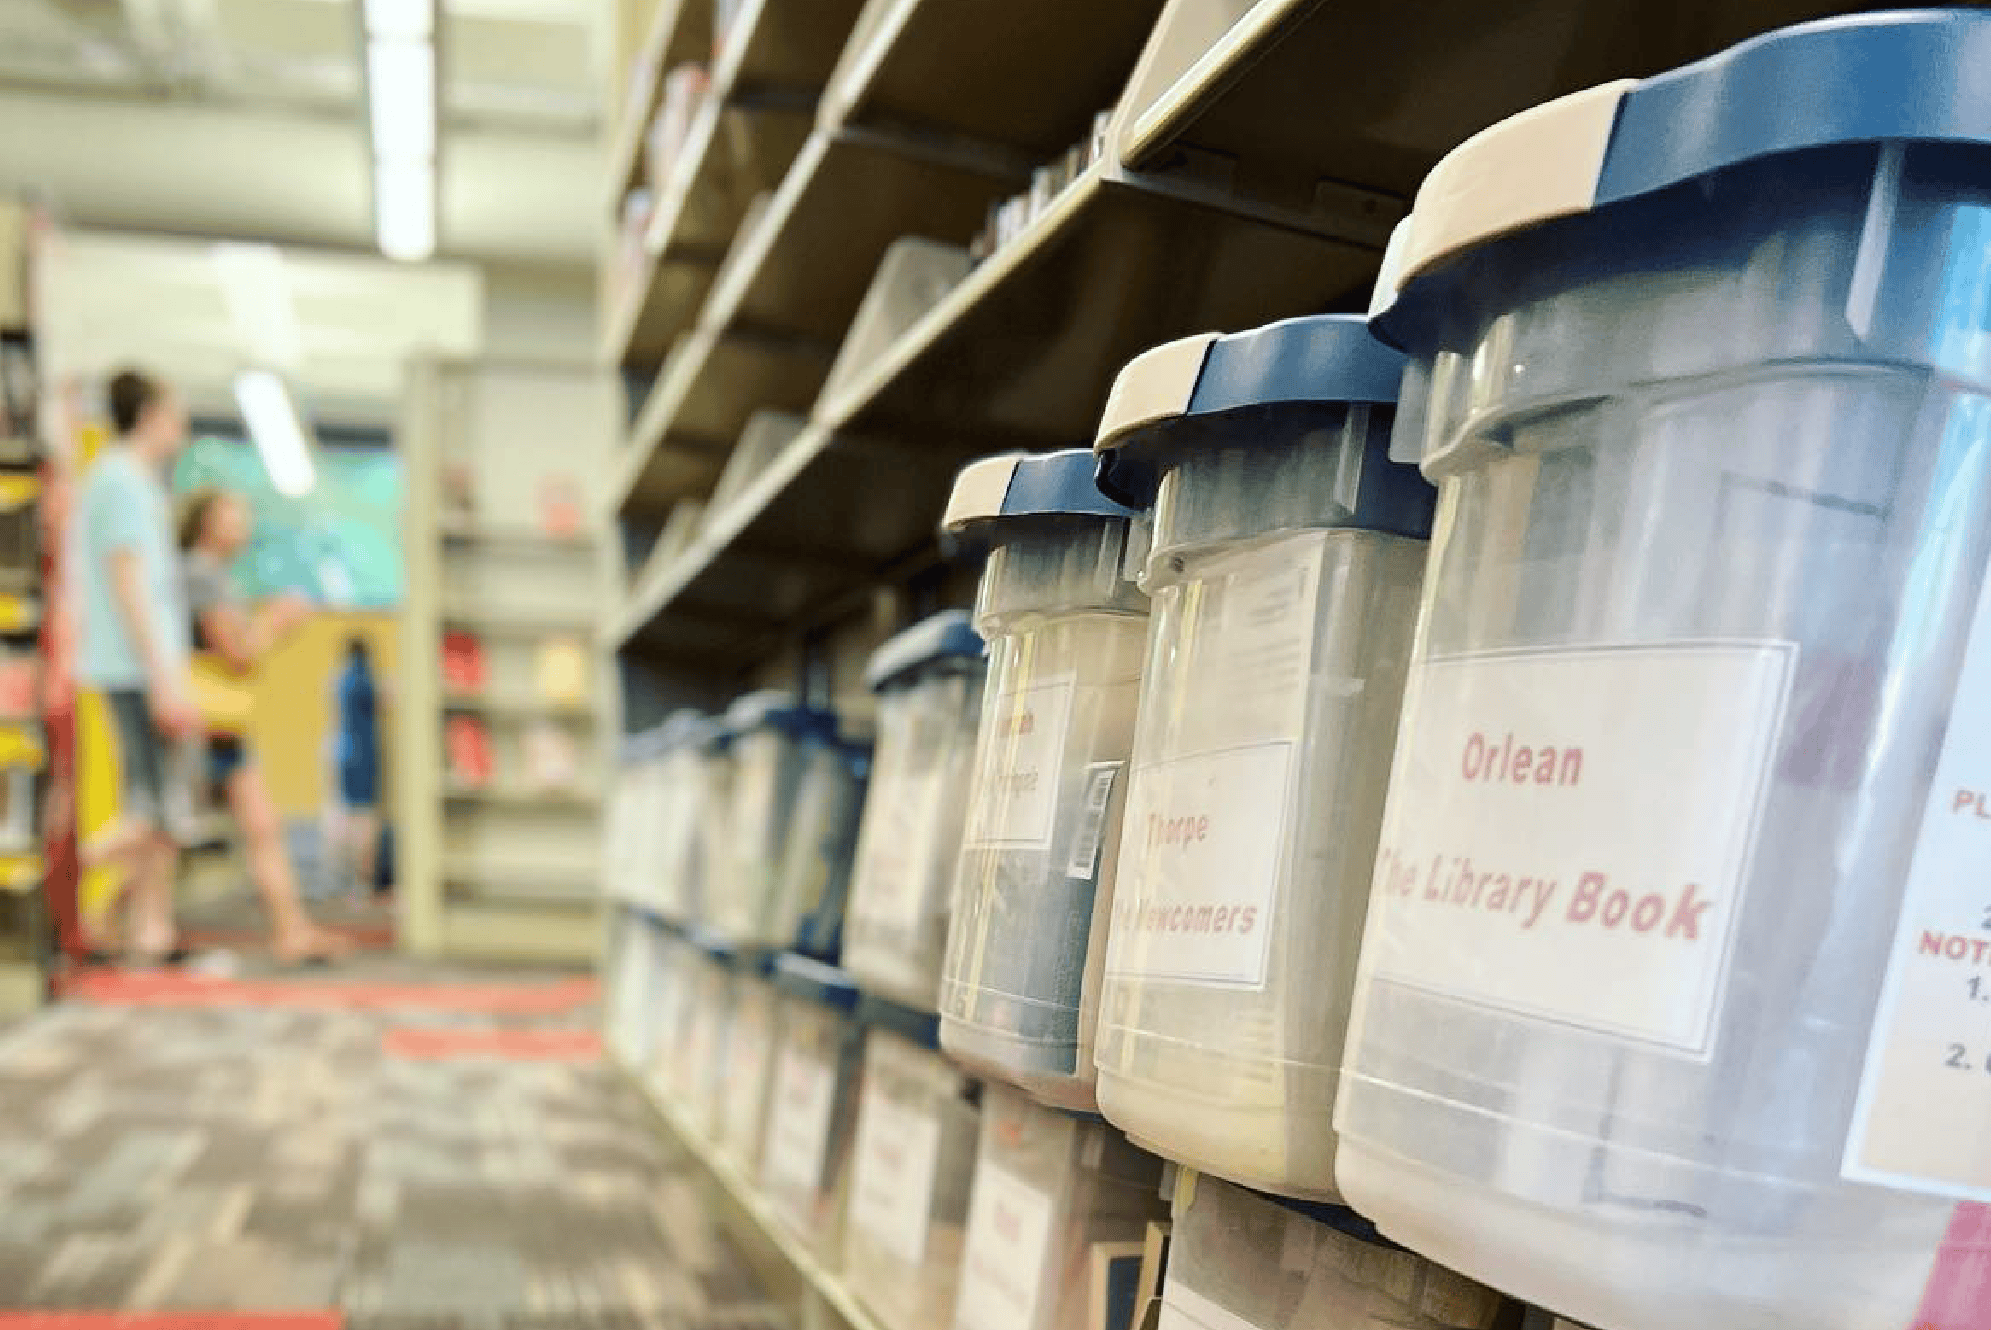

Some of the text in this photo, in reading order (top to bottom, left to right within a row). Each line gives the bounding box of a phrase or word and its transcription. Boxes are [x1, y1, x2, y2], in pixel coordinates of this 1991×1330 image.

[1461, 732, 1584, 786] Orlean
[1423, 854, 1558, 931] Library
[1565, 870, 1714, 941] Book
[1919, 931, 1991, 966] NOT
